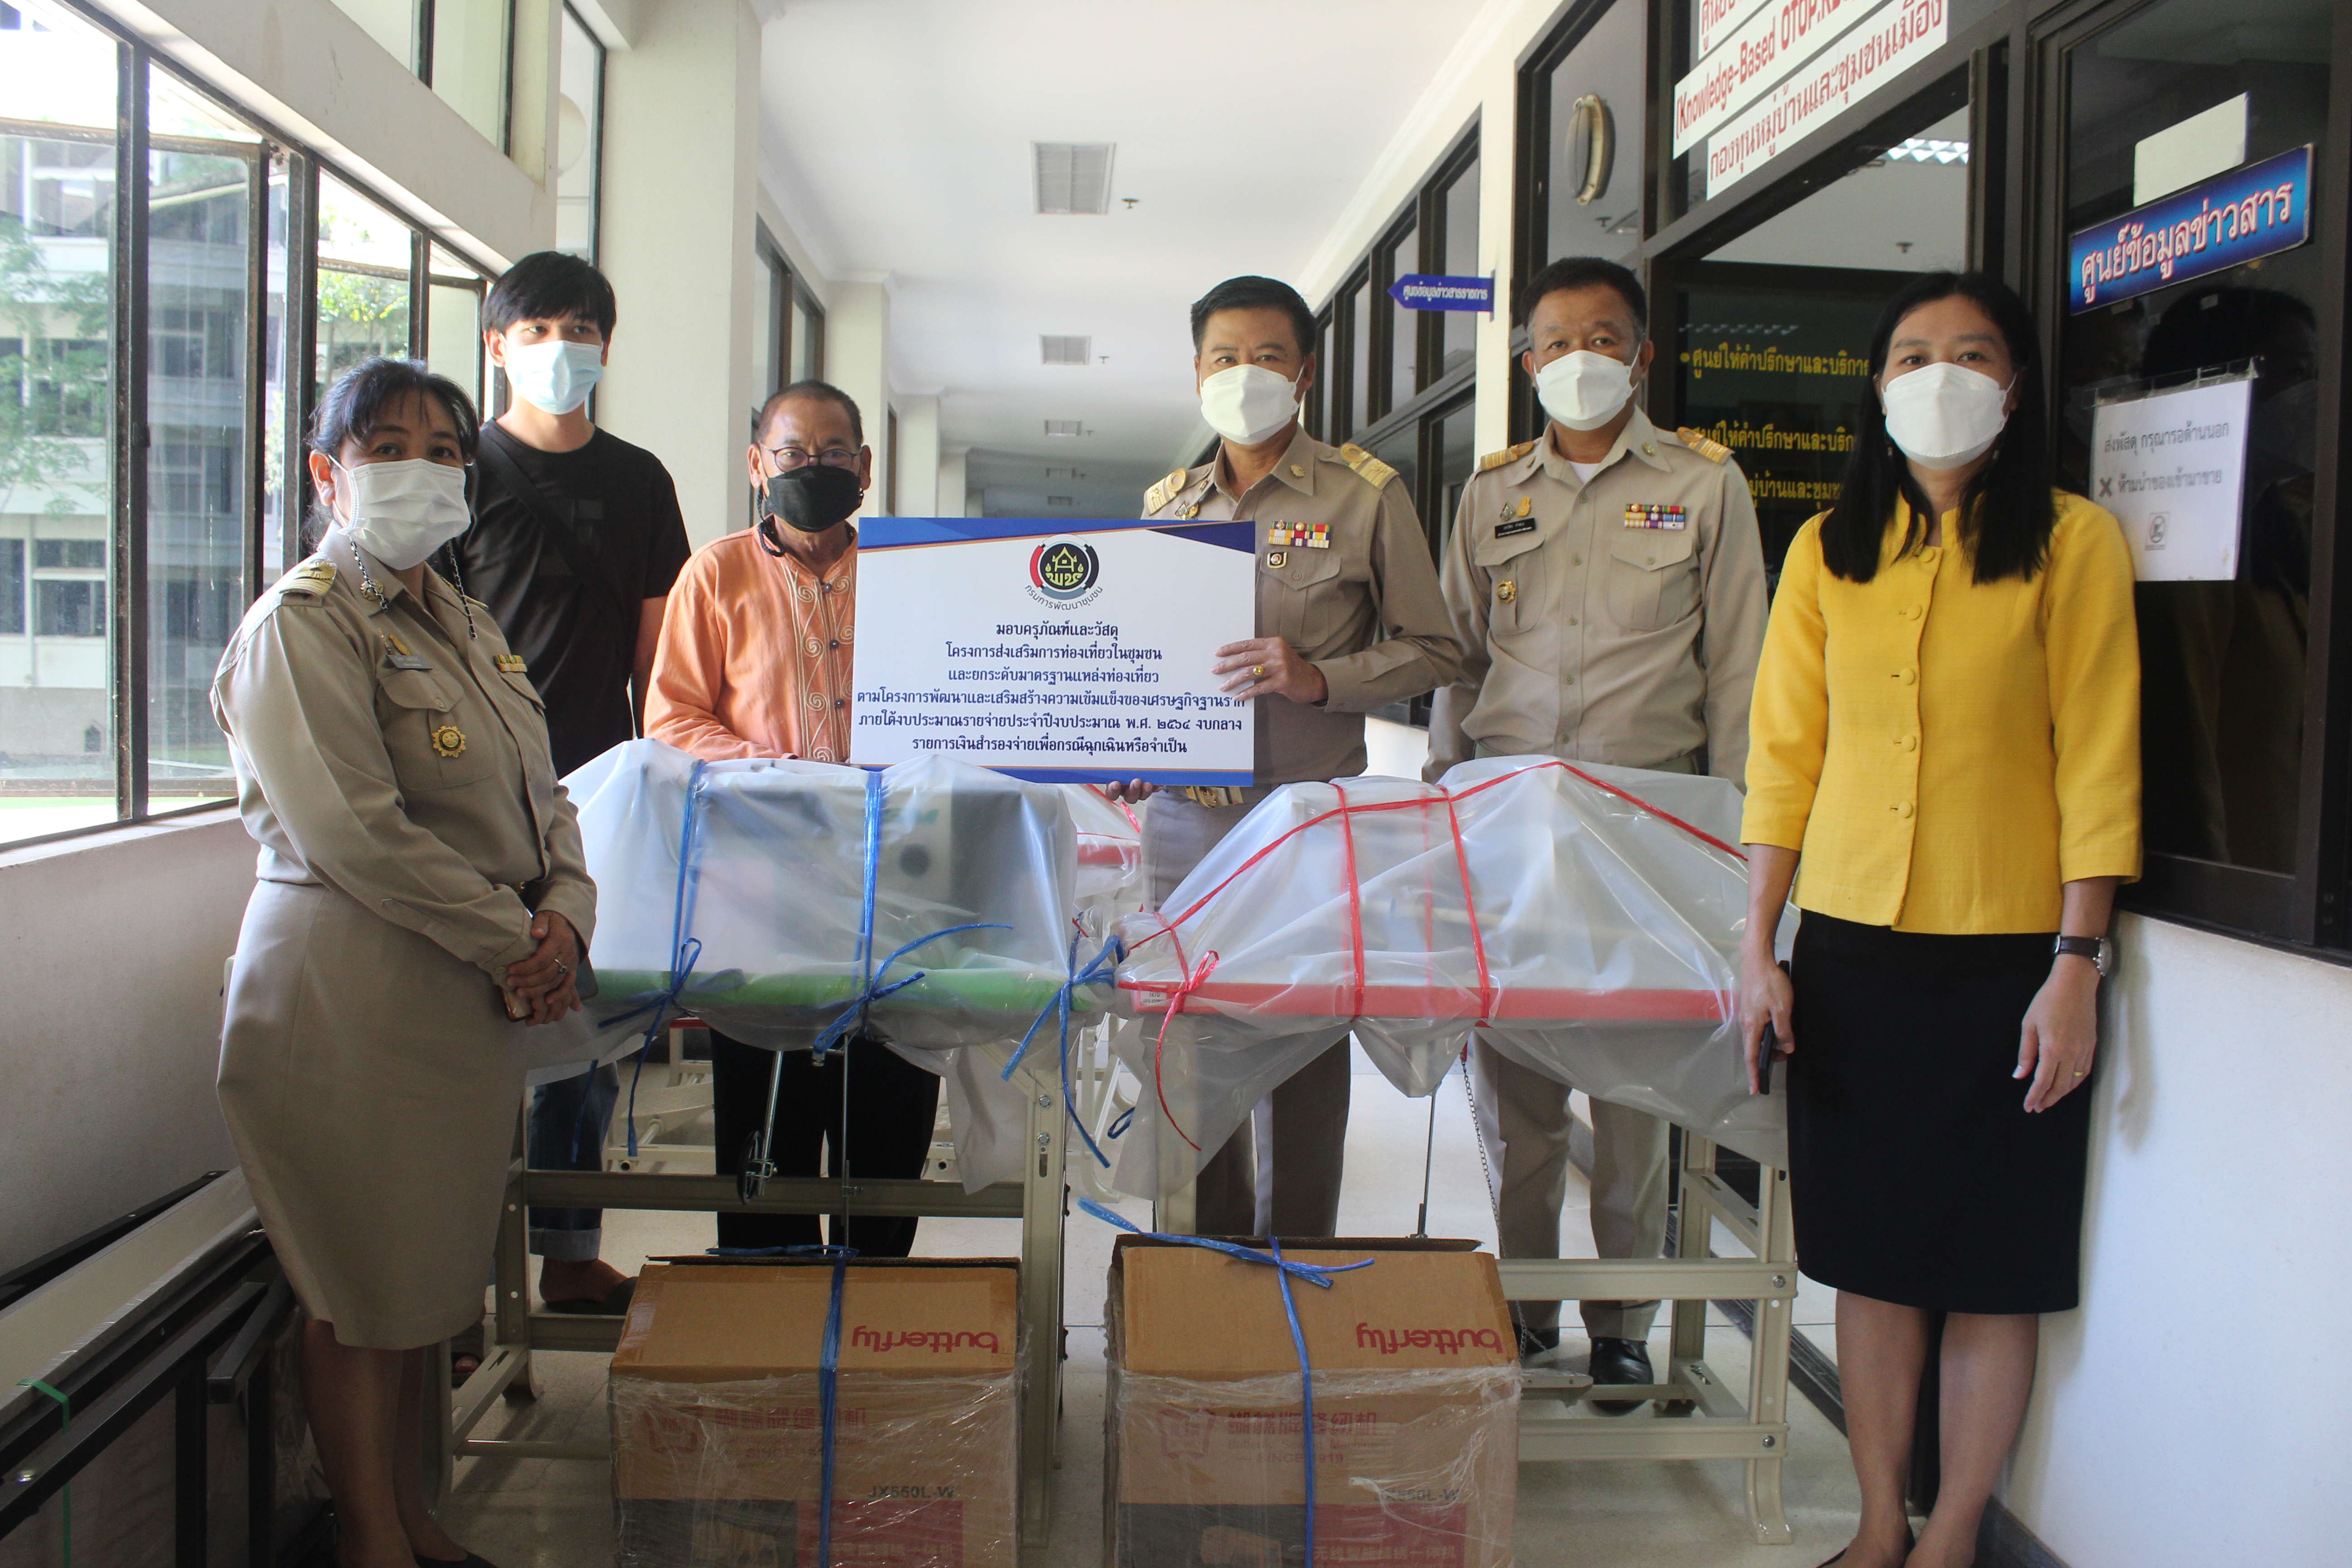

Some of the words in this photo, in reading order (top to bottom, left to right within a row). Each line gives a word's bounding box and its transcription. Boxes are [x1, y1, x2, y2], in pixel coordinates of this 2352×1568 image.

[2081, 182, 2294, 304] ศูนย์ข้อมูลข่าวสาร
[1024, 585, 1103, 611] กรมการพัฒนาชุมชน
[996, 620, 1118, 641] มอบครุภัณฑ์และวัสดุ
[946, 641, 1162, 664] โครงการส่งเสริมการท่องเที่ยวในชุมชน
[948, 665, 1159, 685] และยกระดับมาตรฐานแหล่งท่องเที่ยว
[858, 709, 1121, 729] ภายใต้งบประมาณรายจ่ายประจำปีงบประมาณ
[1126, 717, 1151, 730] พ.ศ.
[1156, 718, 1191, 730] ๒๕๖๔
[1196, 718, 1242, 730] งบกลาง
[912, 732, 1187, 756] รายการเงินสำรองจ่ายเพื่อกรณีฉุกเฉินหรือจำเป็น
[851, 1325, 999, 1353] butterfly
[1357, 1323, 1503, 1354] butterfly
